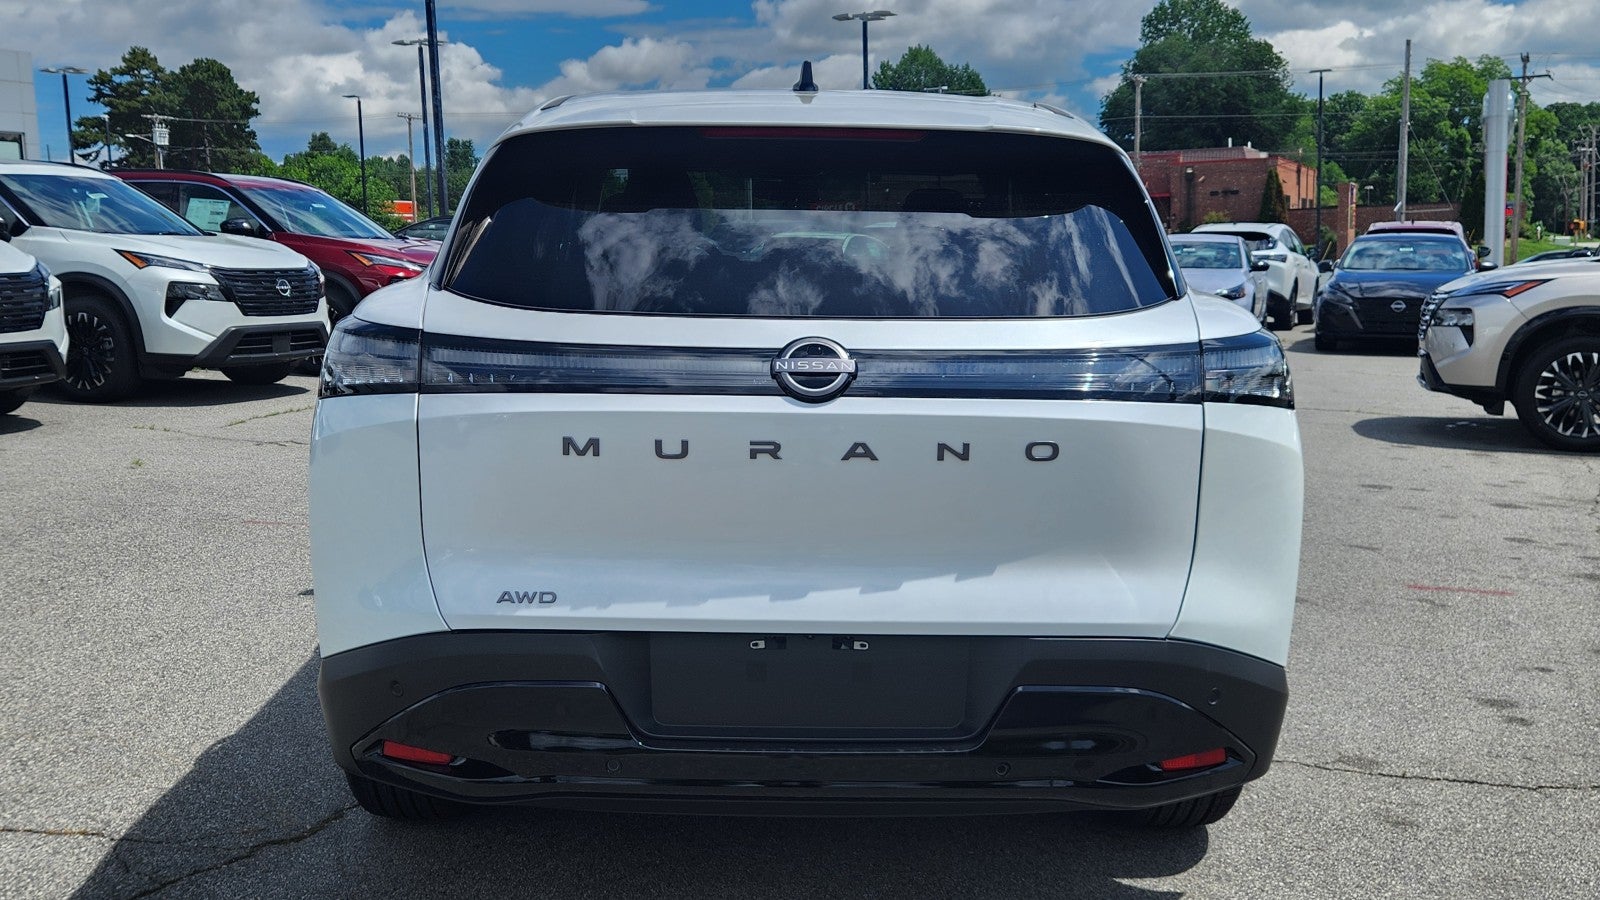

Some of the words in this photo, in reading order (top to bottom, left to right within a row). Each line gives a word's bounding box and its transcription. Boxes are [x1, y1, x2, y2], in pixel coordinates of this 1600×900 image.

[776, 361, 853, 371] NISSAN
[562, 436, 1060, 462] MURANO
[496, 590, 558, 604] AWD
